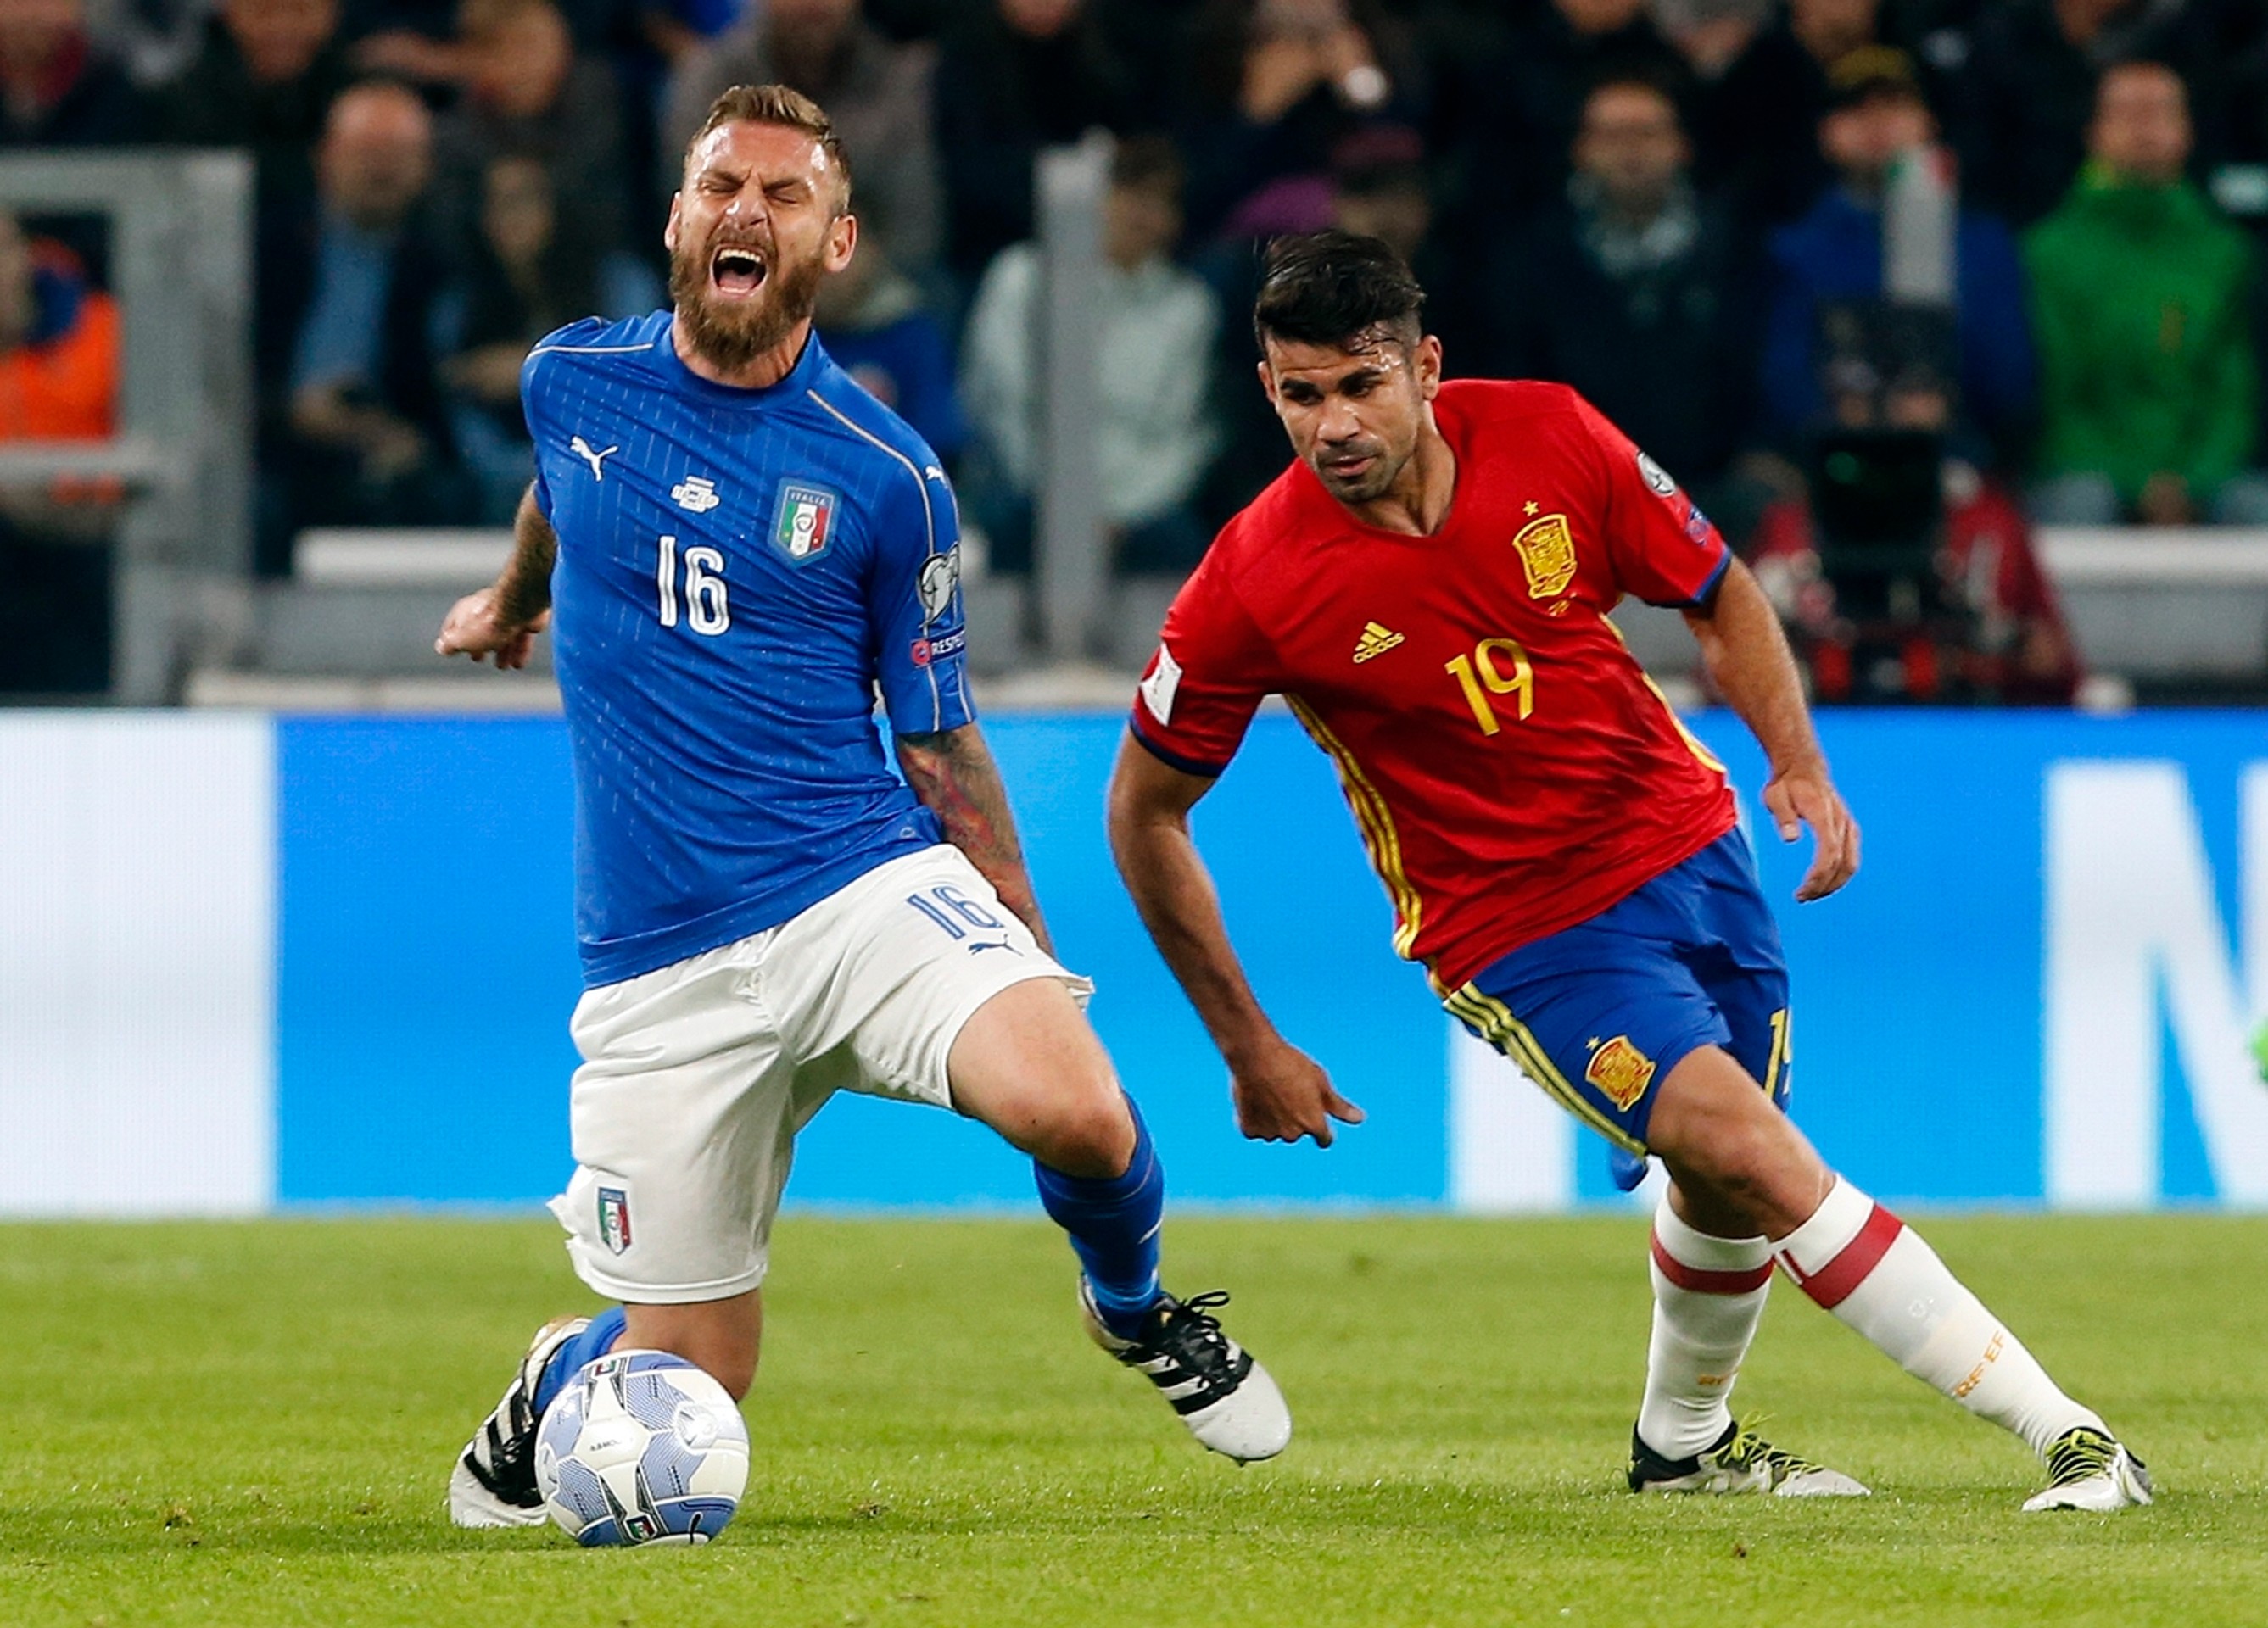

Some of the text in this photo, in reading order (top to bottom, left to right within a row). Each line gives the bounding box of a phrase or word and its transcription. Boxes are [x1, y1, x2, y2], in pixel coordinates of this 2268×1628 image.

[657, 535, 730, 637] 16
[1444, 638, 1533, 736] 19
[906, 886, 1005, 940] 16
